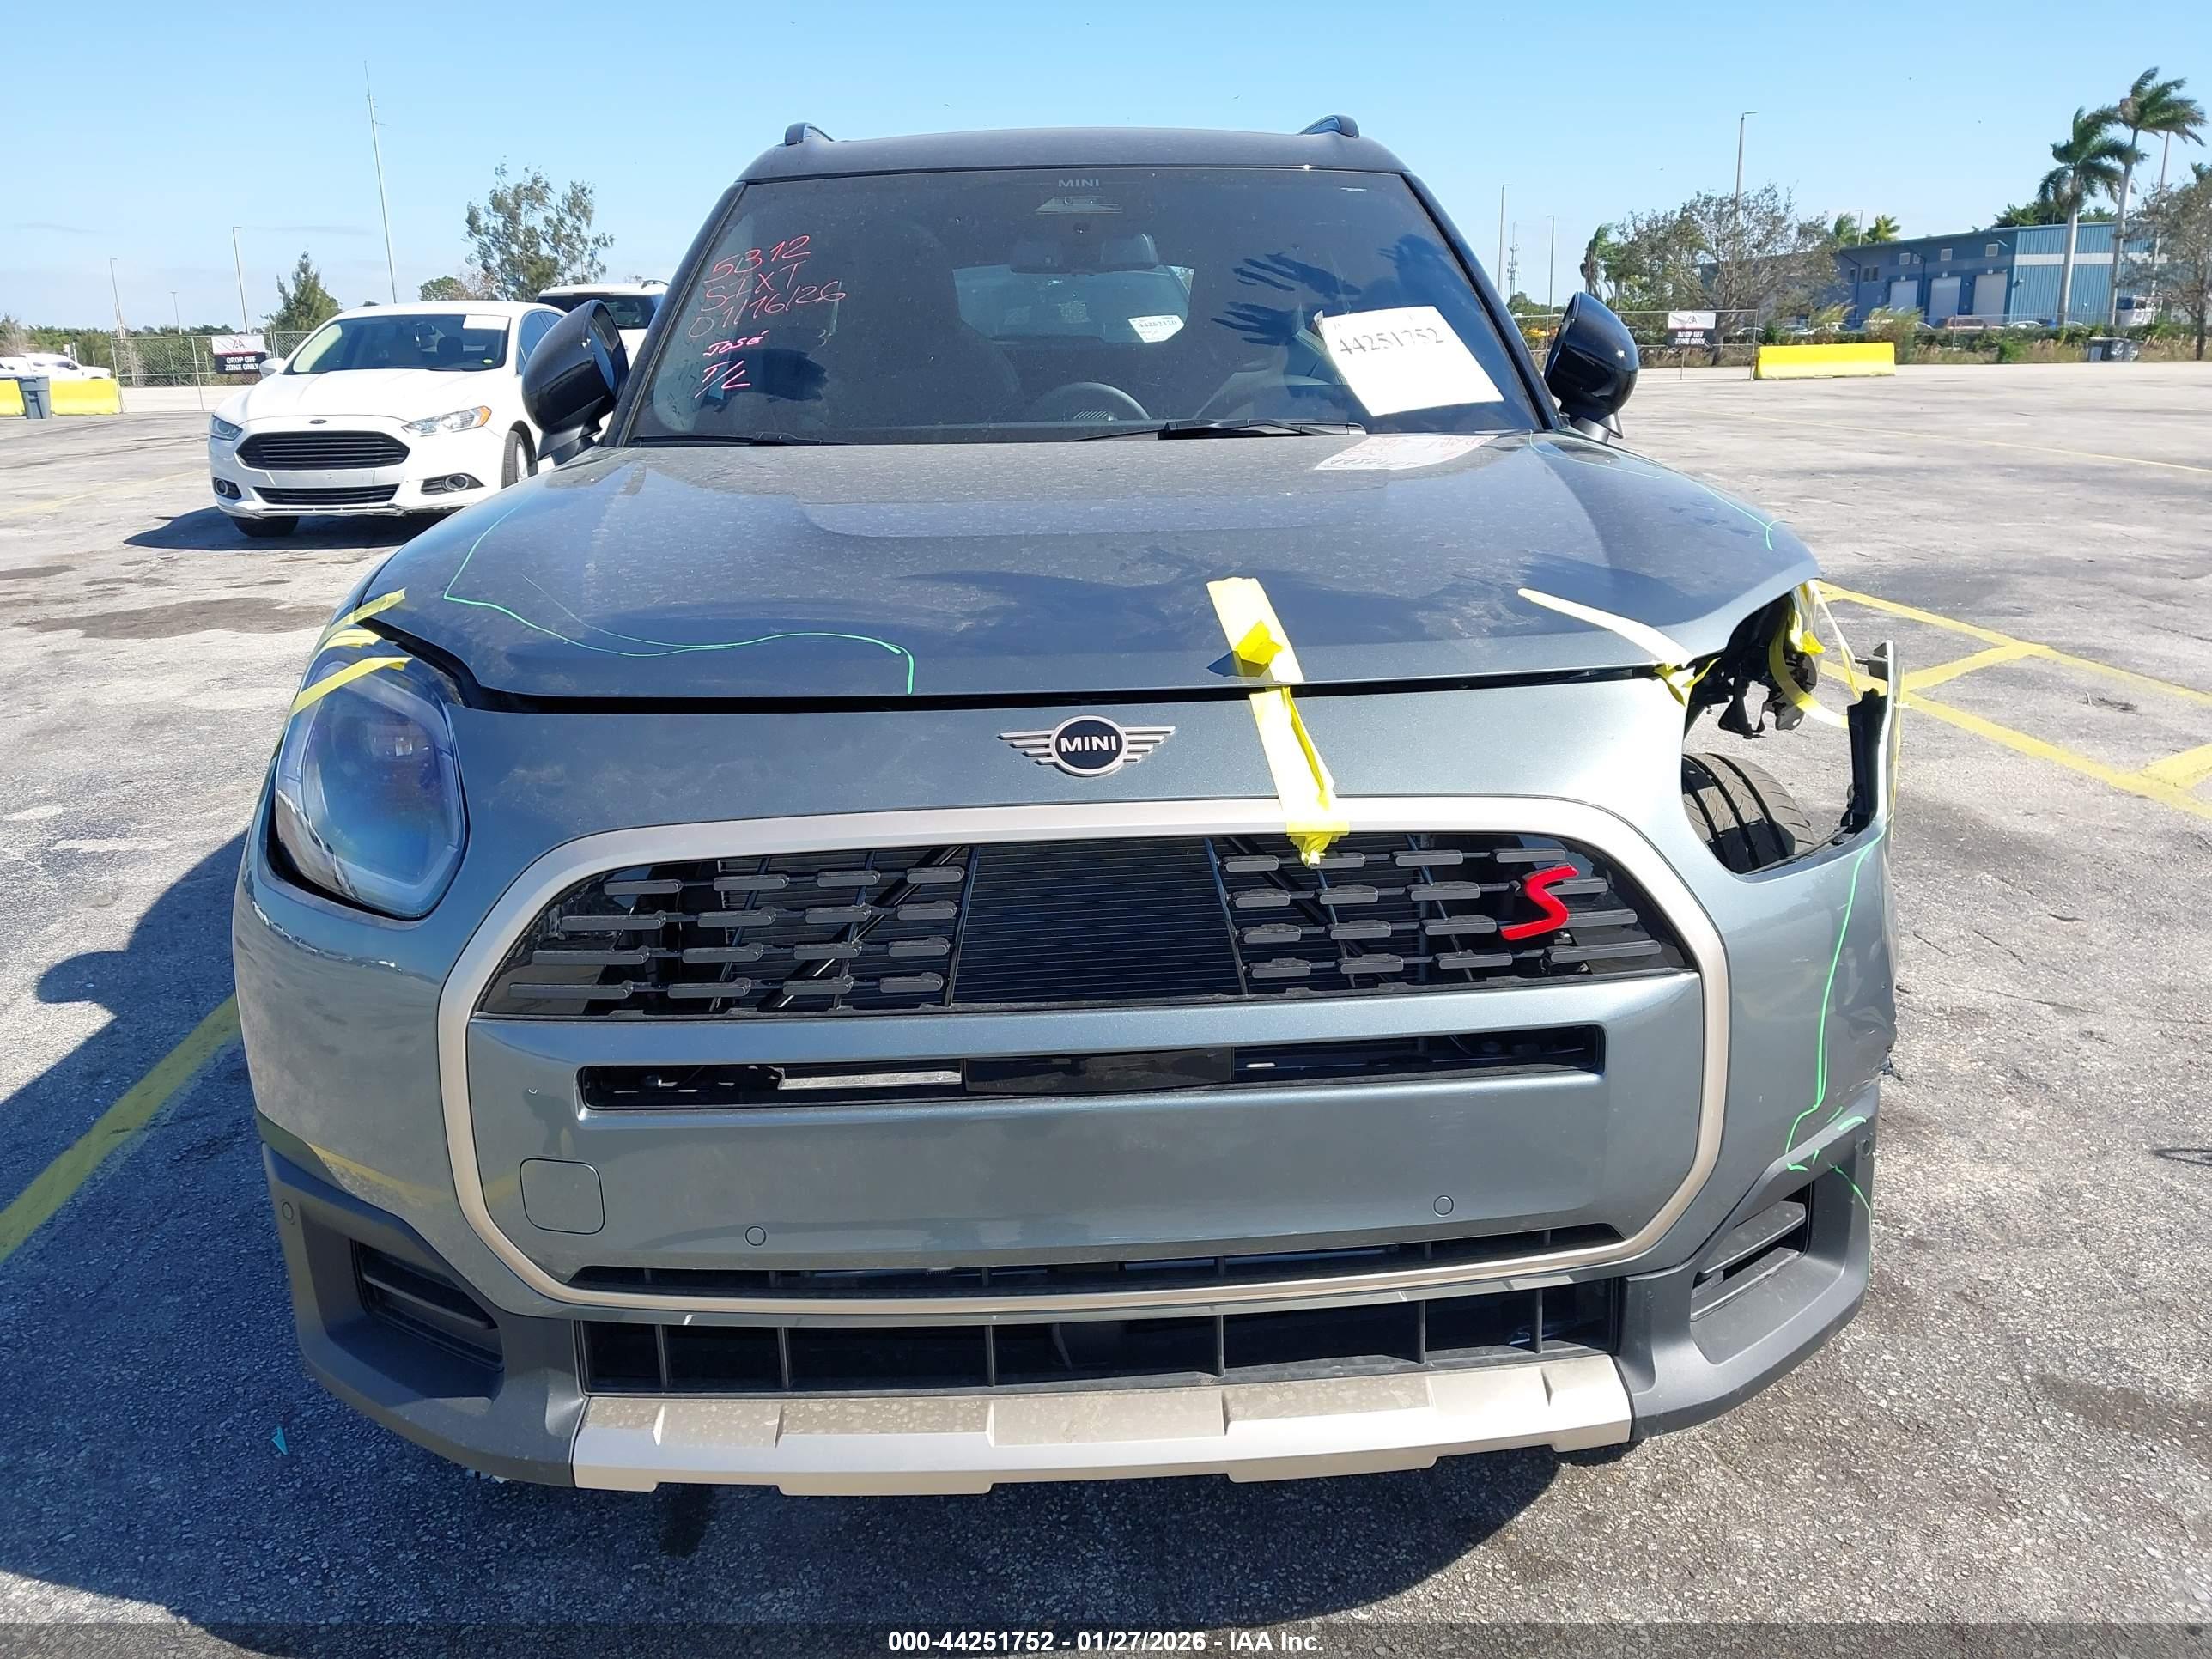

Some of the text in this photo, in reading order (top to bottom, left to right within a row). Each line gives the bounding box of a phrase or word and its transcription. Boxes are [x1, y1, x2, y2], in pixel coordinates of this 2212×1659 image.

[1058, 179, 1099, 187] MINI
[689, 281, 847, 337] 01/16/26
[1340, 327, 1443, 355] 44251752
[1060, 735, 1116, 752] MINI
[1499, 863, 1580, 941] S
